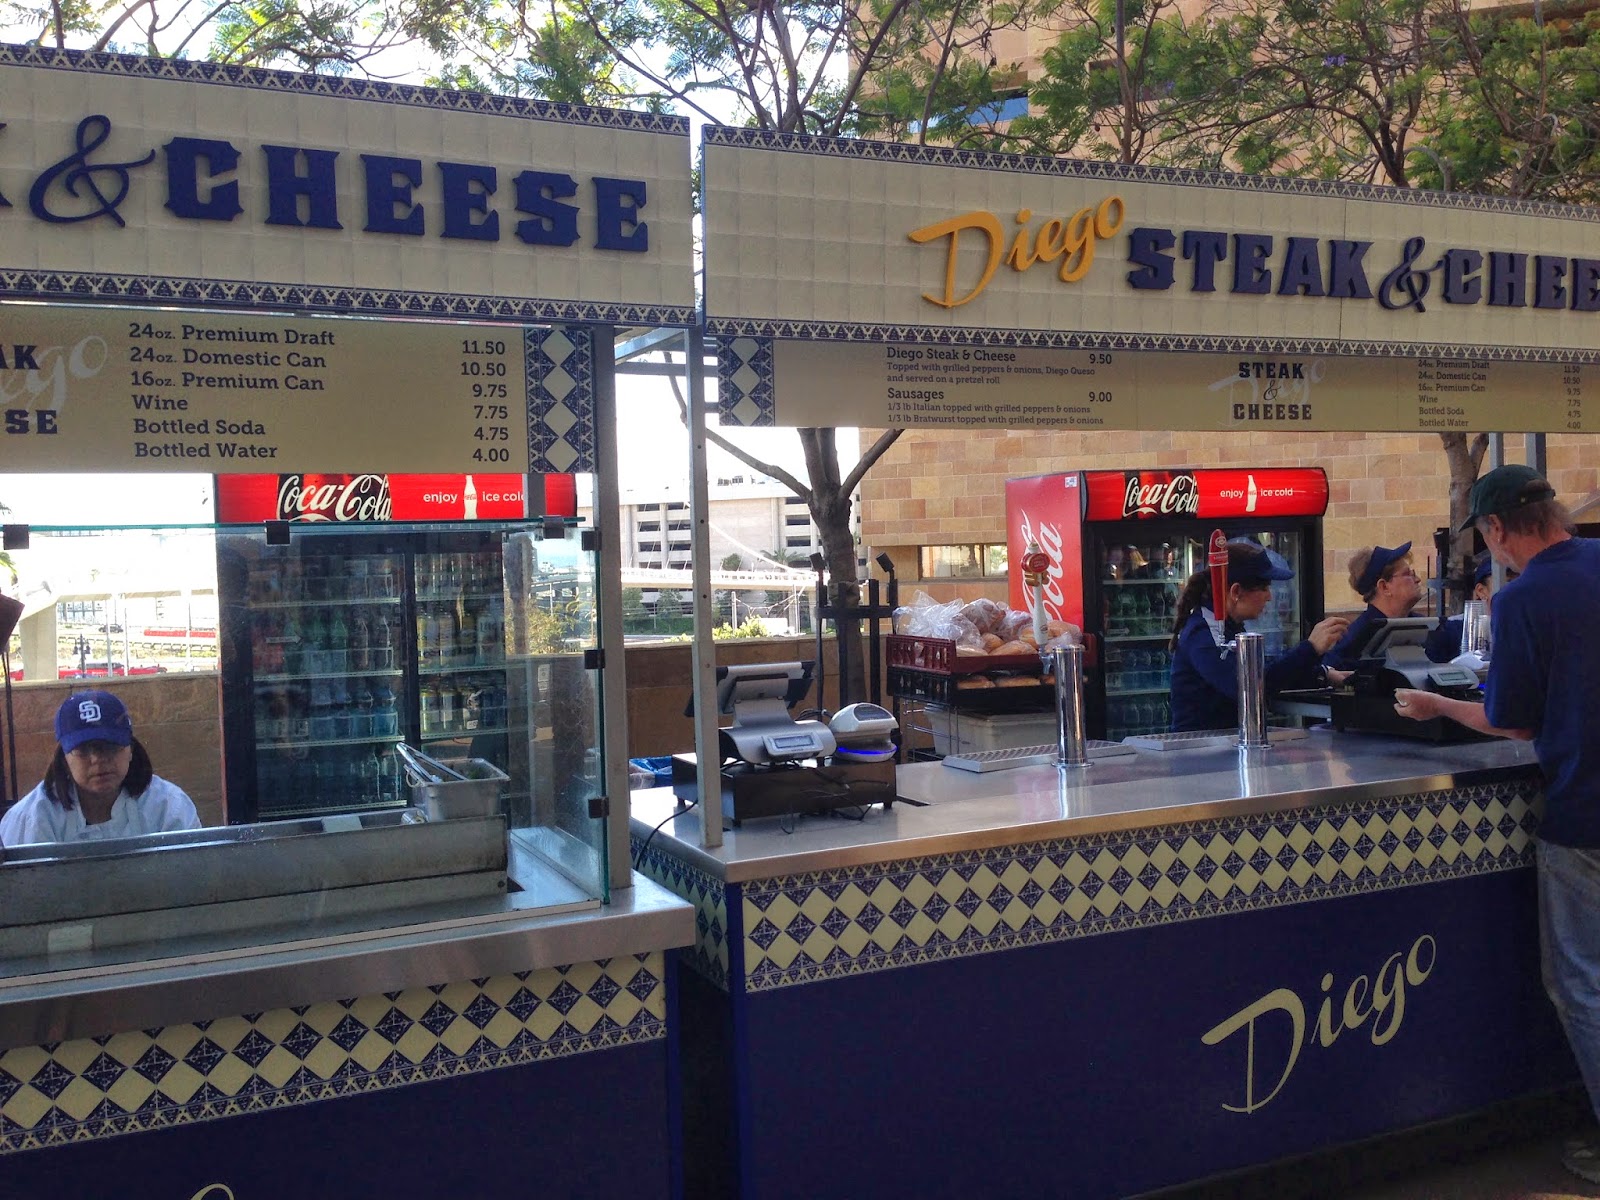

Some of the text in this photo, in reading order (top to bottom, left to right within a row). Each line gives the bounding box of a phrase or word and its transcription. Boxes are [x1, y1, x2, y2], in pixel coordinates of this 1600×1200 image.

[28, 114, 156, 228] &
[162, 136, 649, 252] CHEESE
[907, 195, 1600, 312] Diego STEAK & CHEE
[128, 322, 506, 355] 24oz. Premium Draft 11.50
[130, 346, 507, 377] 24oz. Domestic Can 10.50
[886, 346, 1112, 365] Diego Steak & Cheese 9.50
[1436, 360, 1470, 368] Premium
[1471, 361, 1490, 369] Draft
[887, 362, 919, 372] Topped
[921, 363, 941, 371] with
[942, 364, 970, 373] grilled
[972, 365, 1005, 374] peppers
[1013, 366, 1044, 375] onions,
[1046, 366, 1069, 376] Diego
[1070, 367, 1095, 375] Queso
[1238, 361, 1304, 379] STEAK
[1436, 371, 1471, 380] Domestic
[1472, 372, 1487, 381] Can
[131, 370, 508, 398] 16oz. Premium Can 9.75
[887, 374, 903, 382] and
[905, 374, 934, 383] served
[955, 376, 984, 385] pretzel
[986, 376, 1000, 384] roll
[887, 387, 1112, 402] Sausages 9.00
[1263, 379, 1282, 400] &
[1436, 383, 1470, 392] Premium
[1471, 384, 1486, 392] Can
[1567, 387, 1581, 396] 9.75
[132, 394, 508, 420] Wine 7.75
[887, 402, 901, 411] 1/3
[903, 402, 911, 411] lb
[913, 403, 941, 411] Italian
[943, 403, 972, 413] topped
[974, 404, 993, 412] with
[994, 404, 1021, 414] grilled
[1023, 405, 1055, 414] peppers
[1418, 395, 1438, 403] Wine
[888, 414, 901, 422] 1/3
[903, 414, 911, 422] lb
[913, 414, 955, 423] Bratwurst
[957, 415, 986, 425] topped
[1008, 416, 1034, 425] grilled
[1036, 416, 1068, 425] peppers
[1233, 403, 1312, 420] CHEESE
[1418, 406, 1445, 415] Bottled
[1446, 407, 1464, 415] Soda
[133, 418, 509, 441] Bottled Soda 4.75
[1419, 418, 1581, 430] Bottled Water 4.00
[135, 442, 510, 463] Bottled Water 4.00
[277, 473, 393, 522] Coca-Cola
[422, 491, 458, 505] enjoy
[482, 490, 500, 502] ice
[1122, 474, 1199, 518] Coca-Cola
[1219, 487, 1244, 499] enjoy
[1260, 487, 1273, 497] ice
[1274, 487, 1293, 497] cold
[78, 700, 101, 723] SD
[1200, 934, 1437, 1114] Diego
